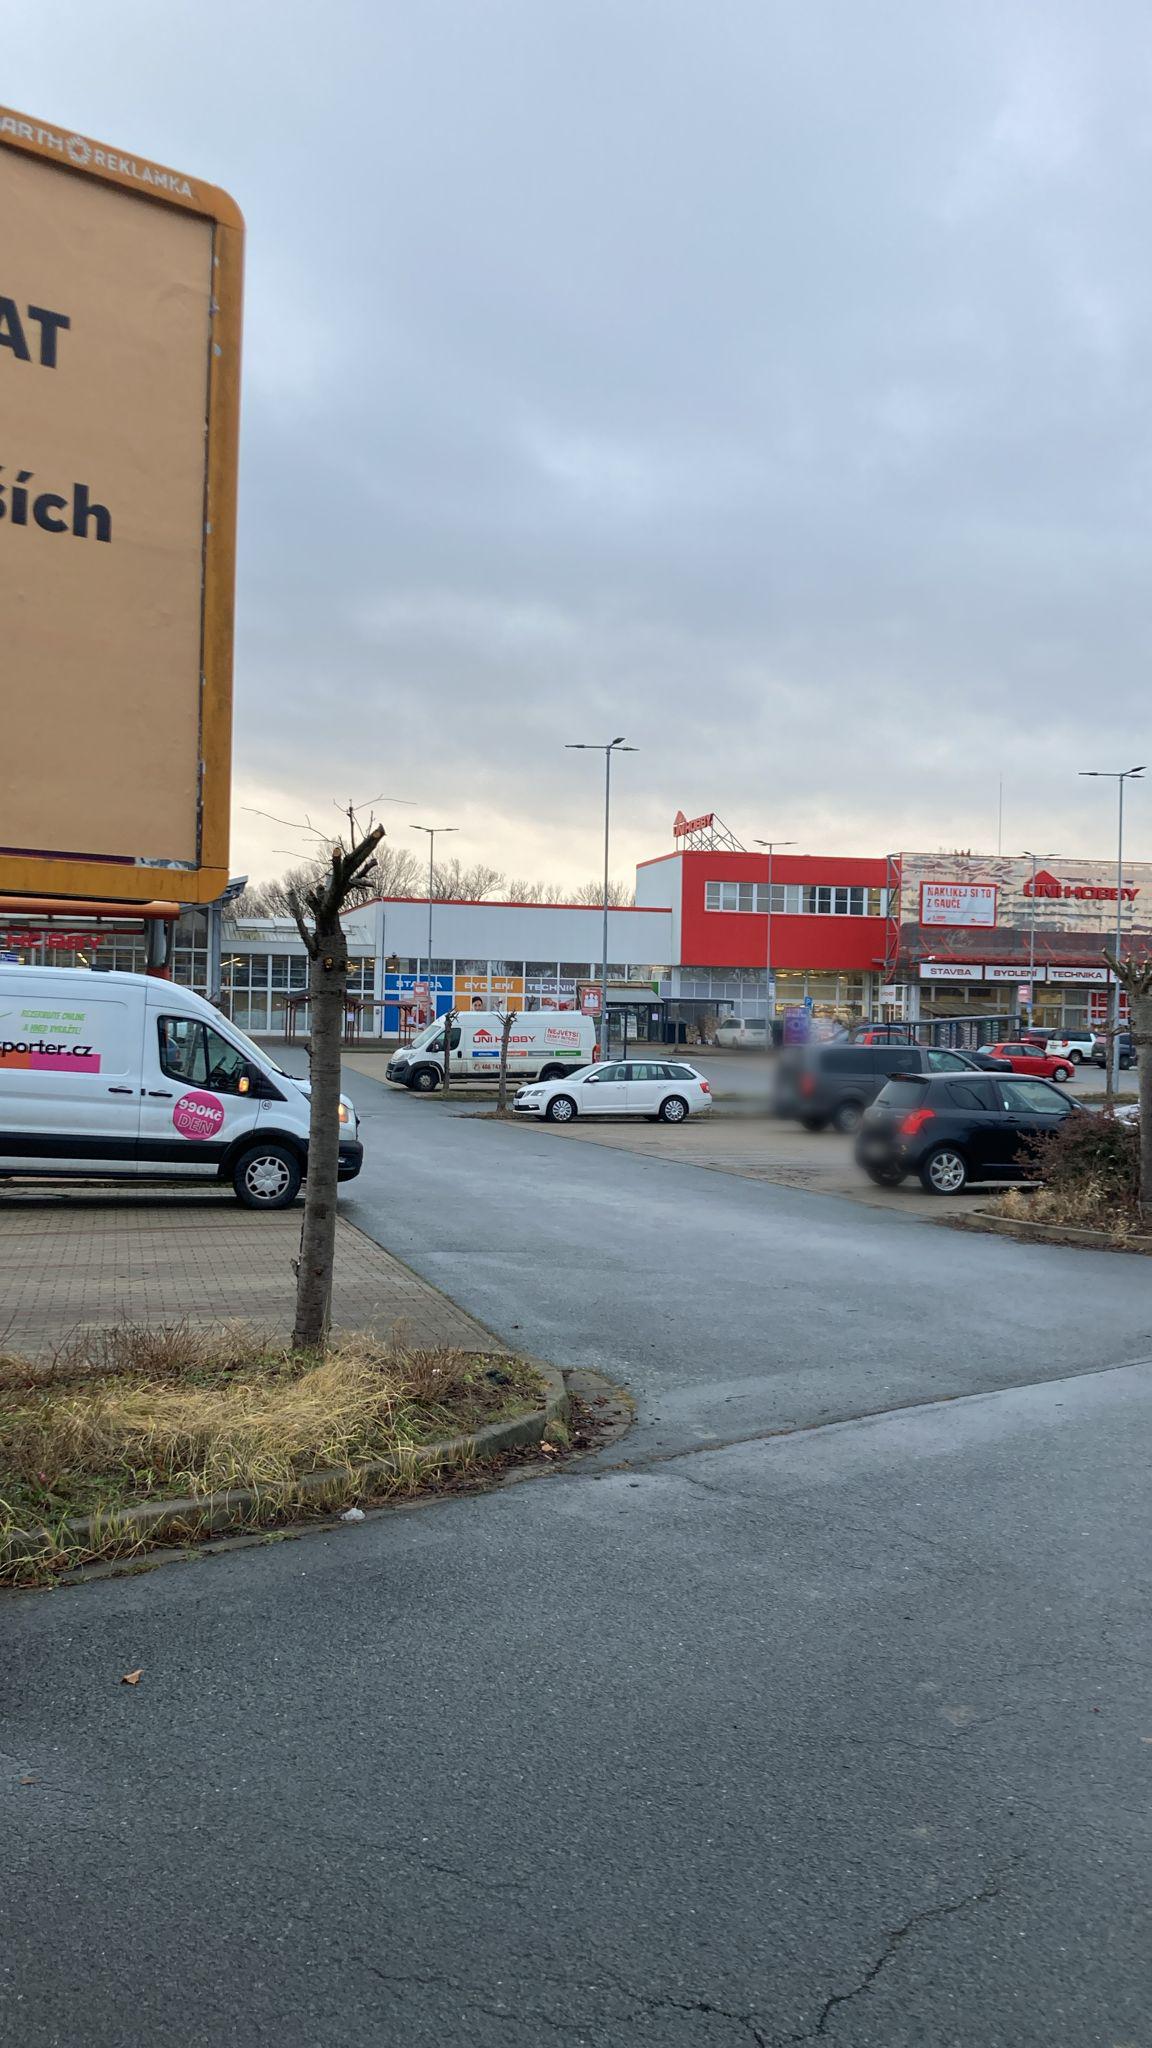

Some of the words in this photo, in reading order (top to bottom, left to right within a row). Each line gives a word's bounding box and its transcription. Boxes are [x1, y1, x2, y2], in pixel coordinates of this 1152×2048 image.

[685, 813, 714, 834] HOBBY
[927, 886, 968, 897] NAKLIKEJ
[970, 888, 979, 898] SI
[981, 889, 992, 898] TO
[1023, 884, 1062, 898] UNI
[1064, 886, 1140, 901] HOBBY
[926, 898, 933, 908] Z
[934, 897, 961, 909] GAUČE
[929, 967, 972, 976] STAVBA
[993, 968, 1039, 977] BYDLENÍ
[1051, 970, 1103, 979] TECHNIKA
[464, 981, 514, 990] BYDLENÍ
[178, 1100, 222, 1121] 990Kč
[177, 1113, 214, 1135] DEN
